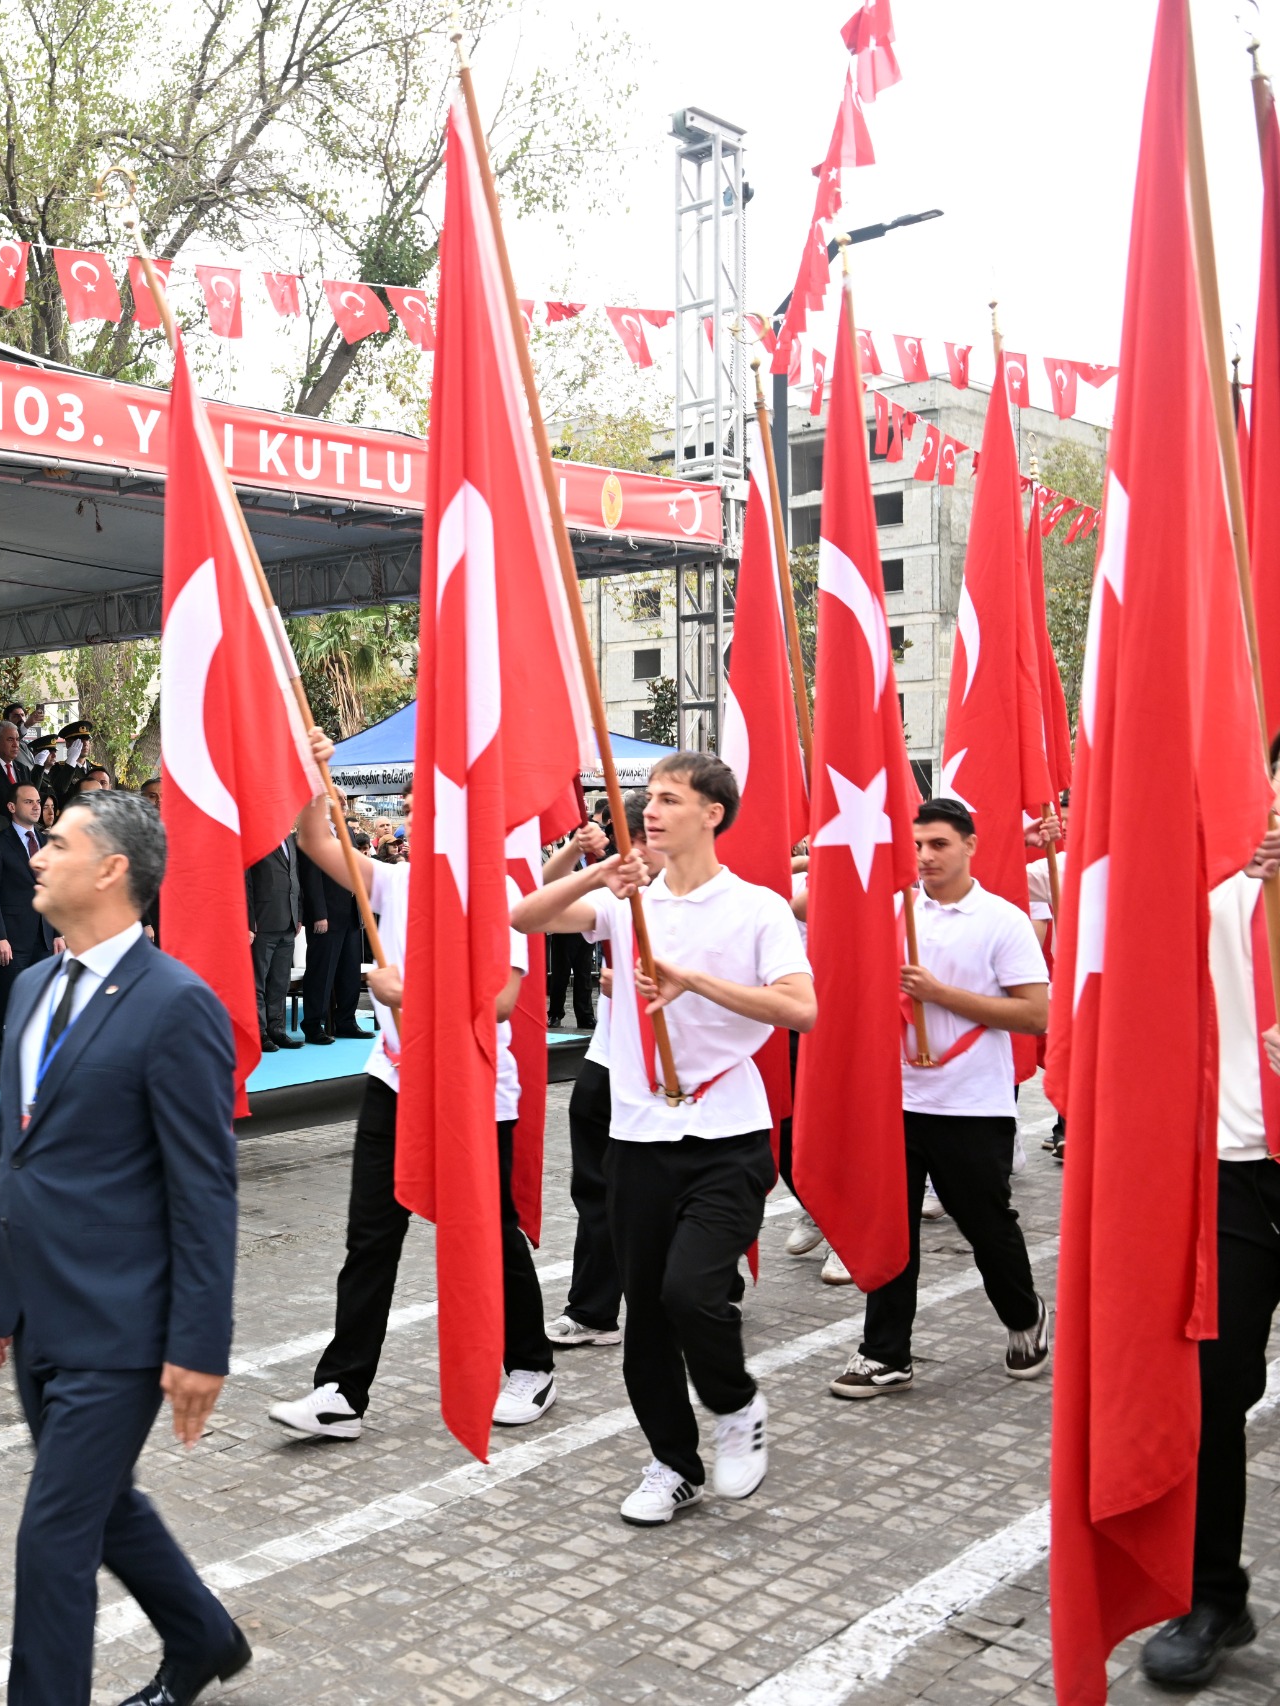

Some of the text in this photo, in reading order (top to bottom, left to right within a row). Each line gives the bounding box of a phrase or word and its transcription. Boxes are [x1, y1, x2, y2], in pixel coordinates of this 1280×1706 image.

[127, 404, 234, 468] YI
[258, 430, 412, 494] KUTLU
[340, 769, 380, 790] Büyükşehir
[382, 767, 414, 785] Belediye
